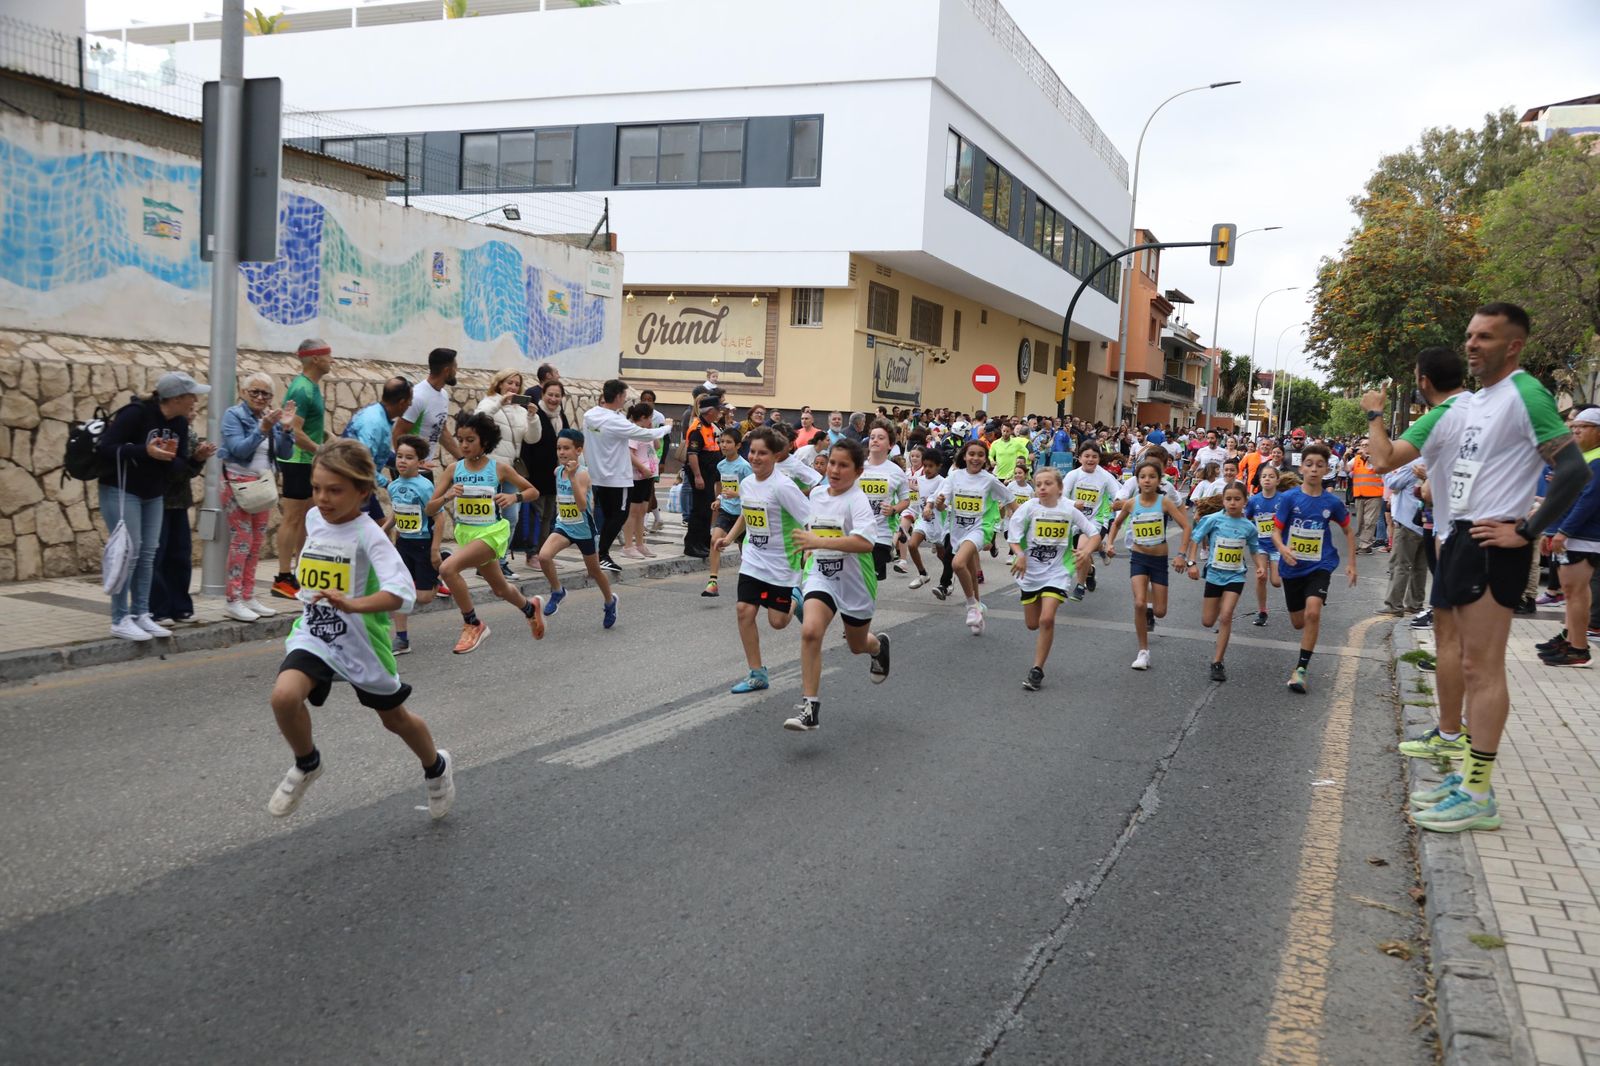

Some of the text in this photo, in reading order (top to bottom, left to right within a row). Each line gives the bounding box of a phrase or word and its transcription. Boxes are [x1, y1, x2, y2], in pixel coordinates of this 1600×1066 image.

[626, 305, 643, 317] LE
[634, 305, 730, 355] Grand
[720, 336, 752, 348] CAFÉ
[885, 357, 911, 389] Grand
[456, 474, 485, 483] nerja
[862, 484, 886, 494] 1036
[1077, 492, 1097, 503] 1072
[459, 503, 490, 515] 1030
[956, 501, 980, 512] 1033
[1037, 526, 1066, 538] 1039
[1135, 526, 1162, 538] 1016
[1291, 541, 1319, 553] 1034
[301, 567, 345, 591] 1051
